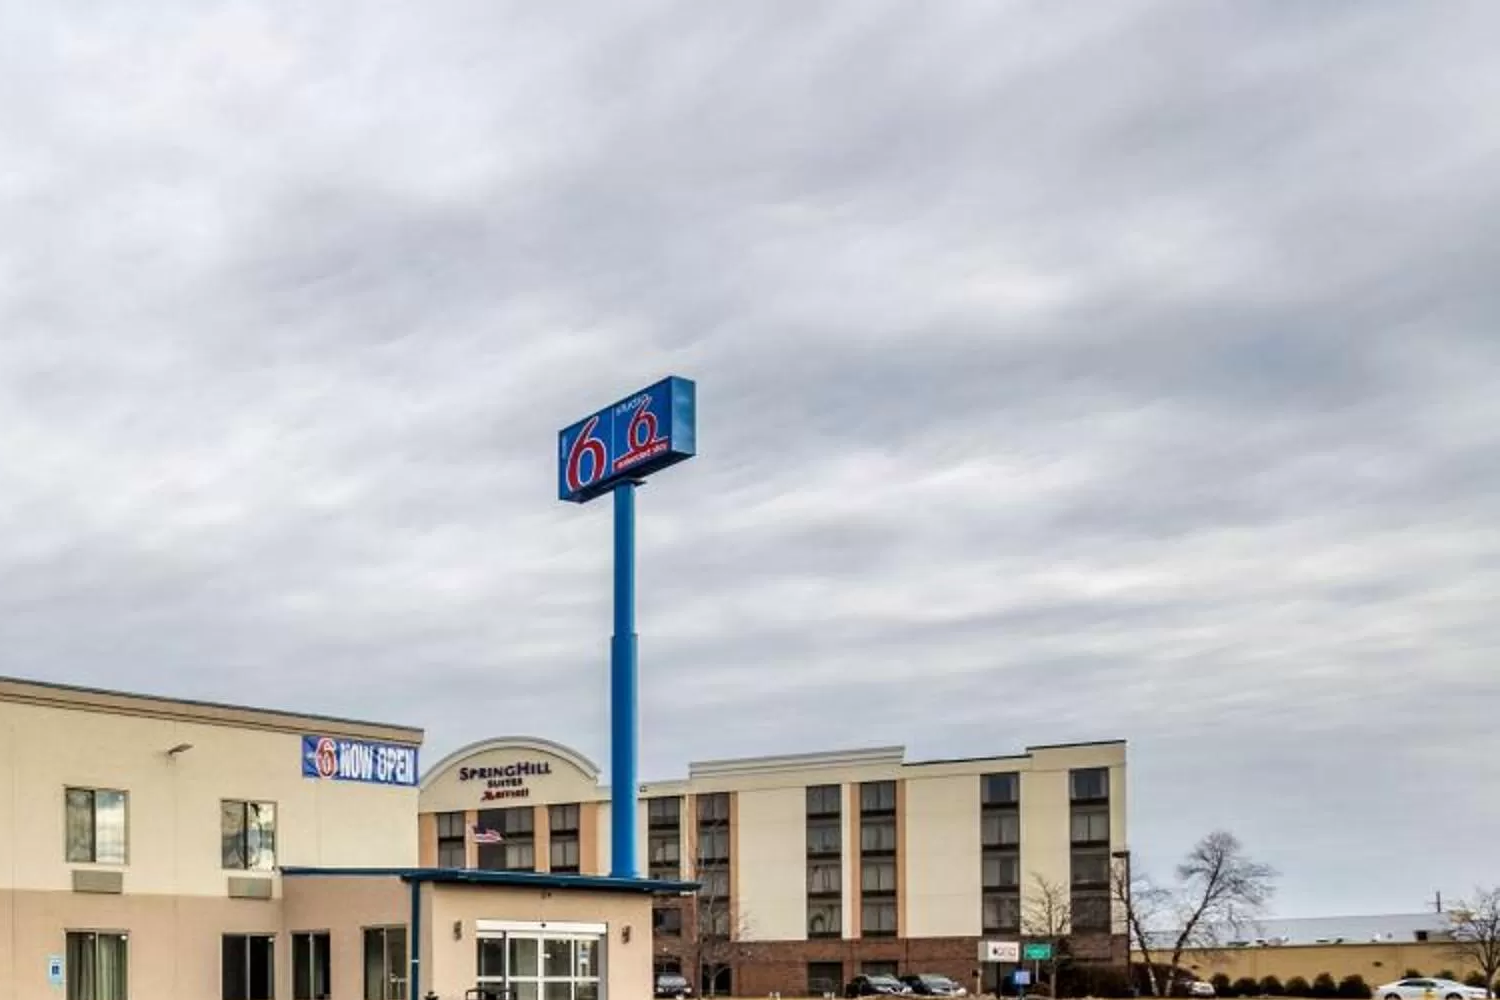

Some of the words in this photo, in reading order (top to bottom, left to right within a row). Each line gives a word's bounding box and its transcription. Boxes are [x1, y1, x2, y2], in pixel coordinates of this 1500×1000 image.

[628, 394, 659, 453] 6
[566, 416, 607, 492] 6
[316, 737, 338, 778] 6
[340, 742, 373, 779] NOW
[377, 746, 415, 784] OPEN
